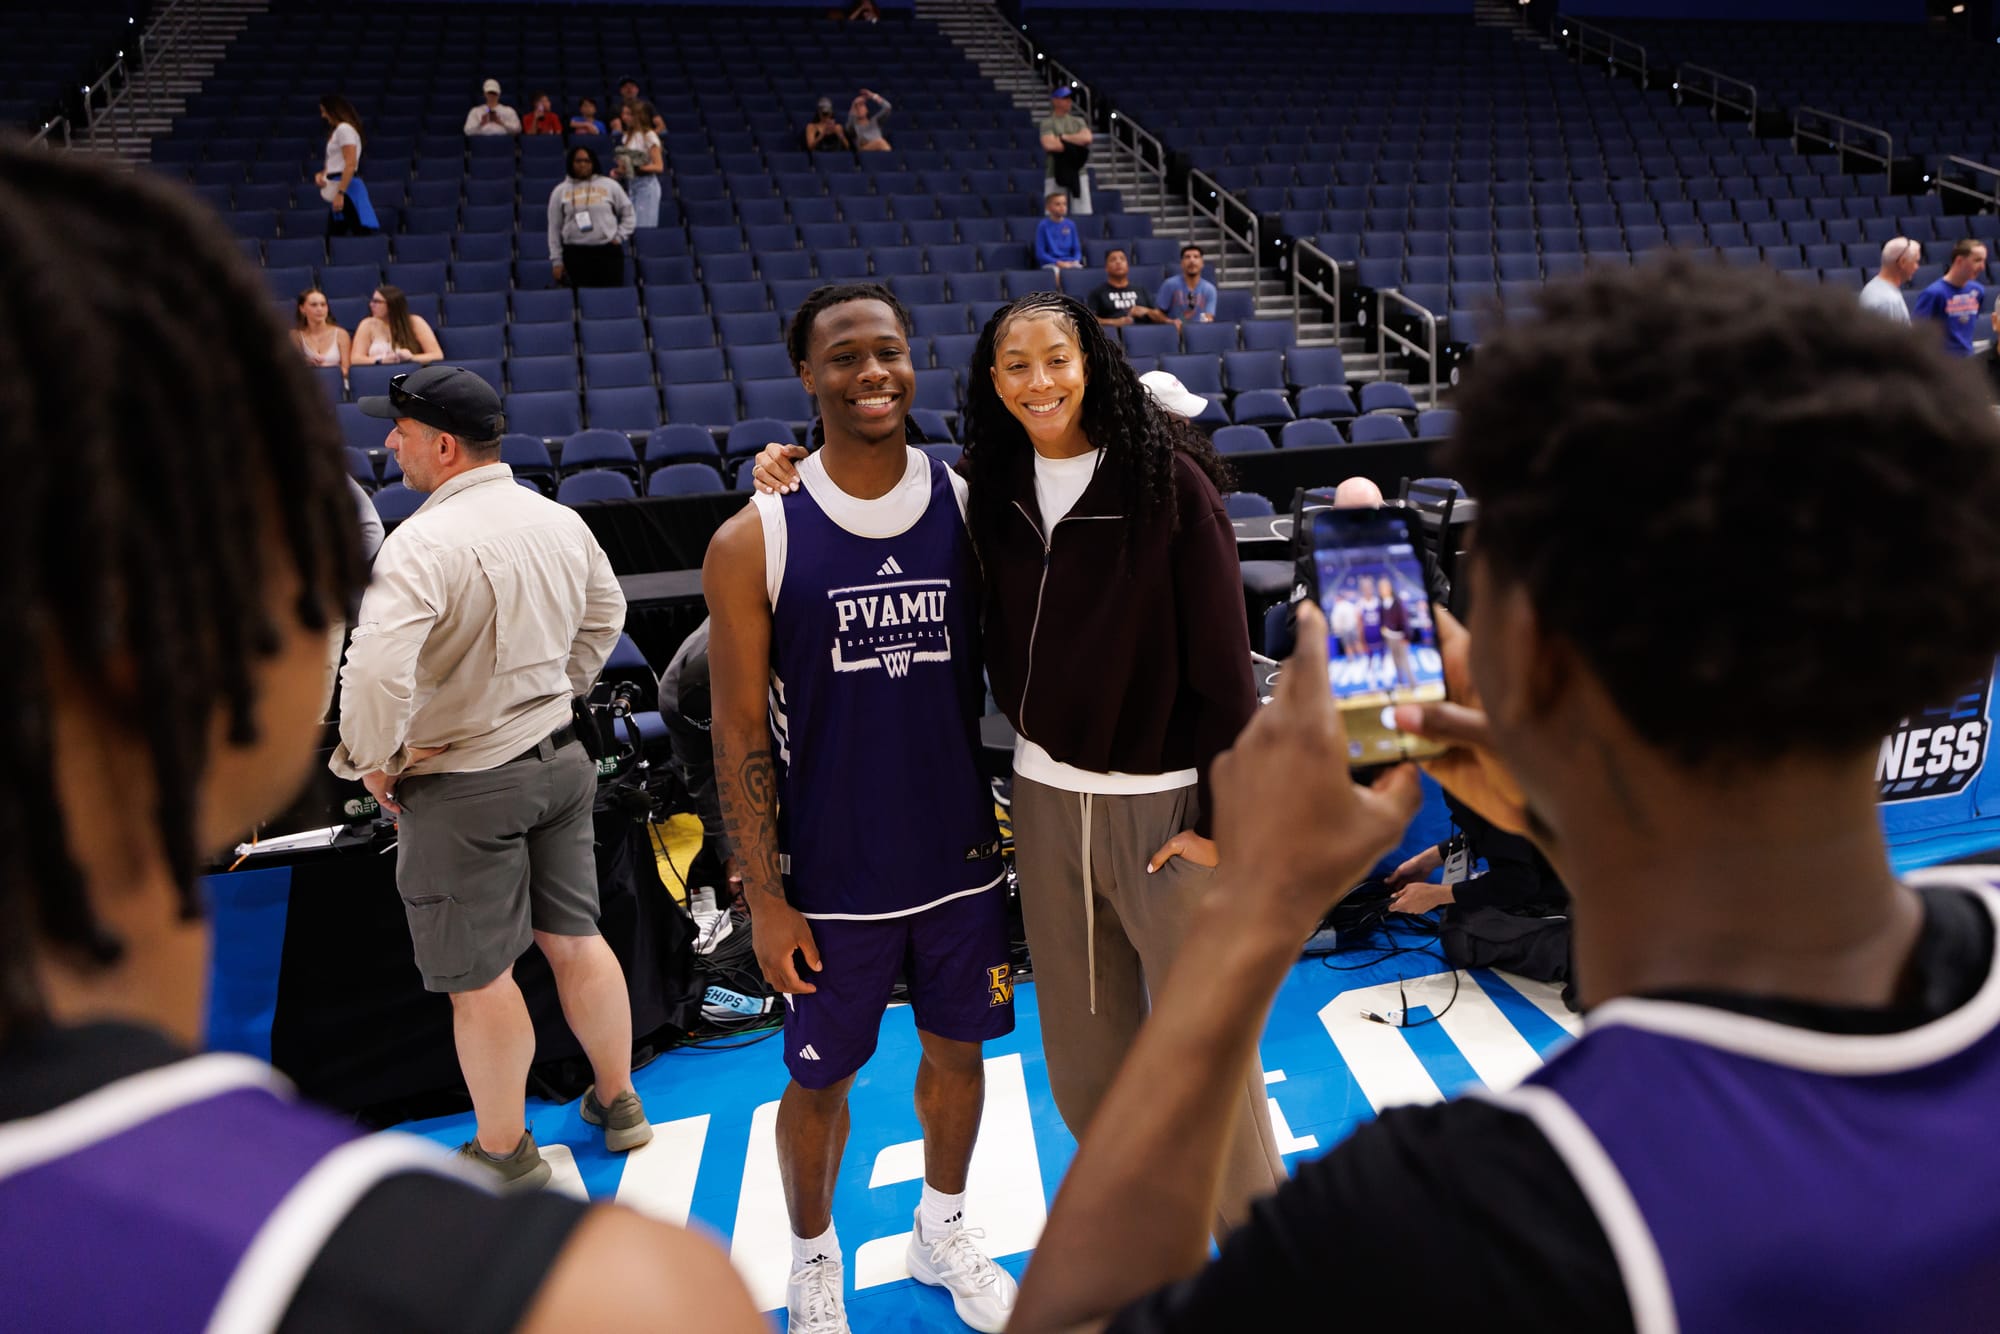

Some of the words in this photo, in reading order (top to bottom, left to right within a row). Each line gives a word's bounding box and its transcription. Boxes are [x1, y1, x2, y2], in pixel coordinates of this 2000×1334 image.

[835, 591, 947, 631] PVAMU
[848, 631, 943, 647] BASKETBALL
[1875, 721, 1982, 781] NESS
[597, 763, 617, 775] NEP
[355, 802, 378, 815] NEP
